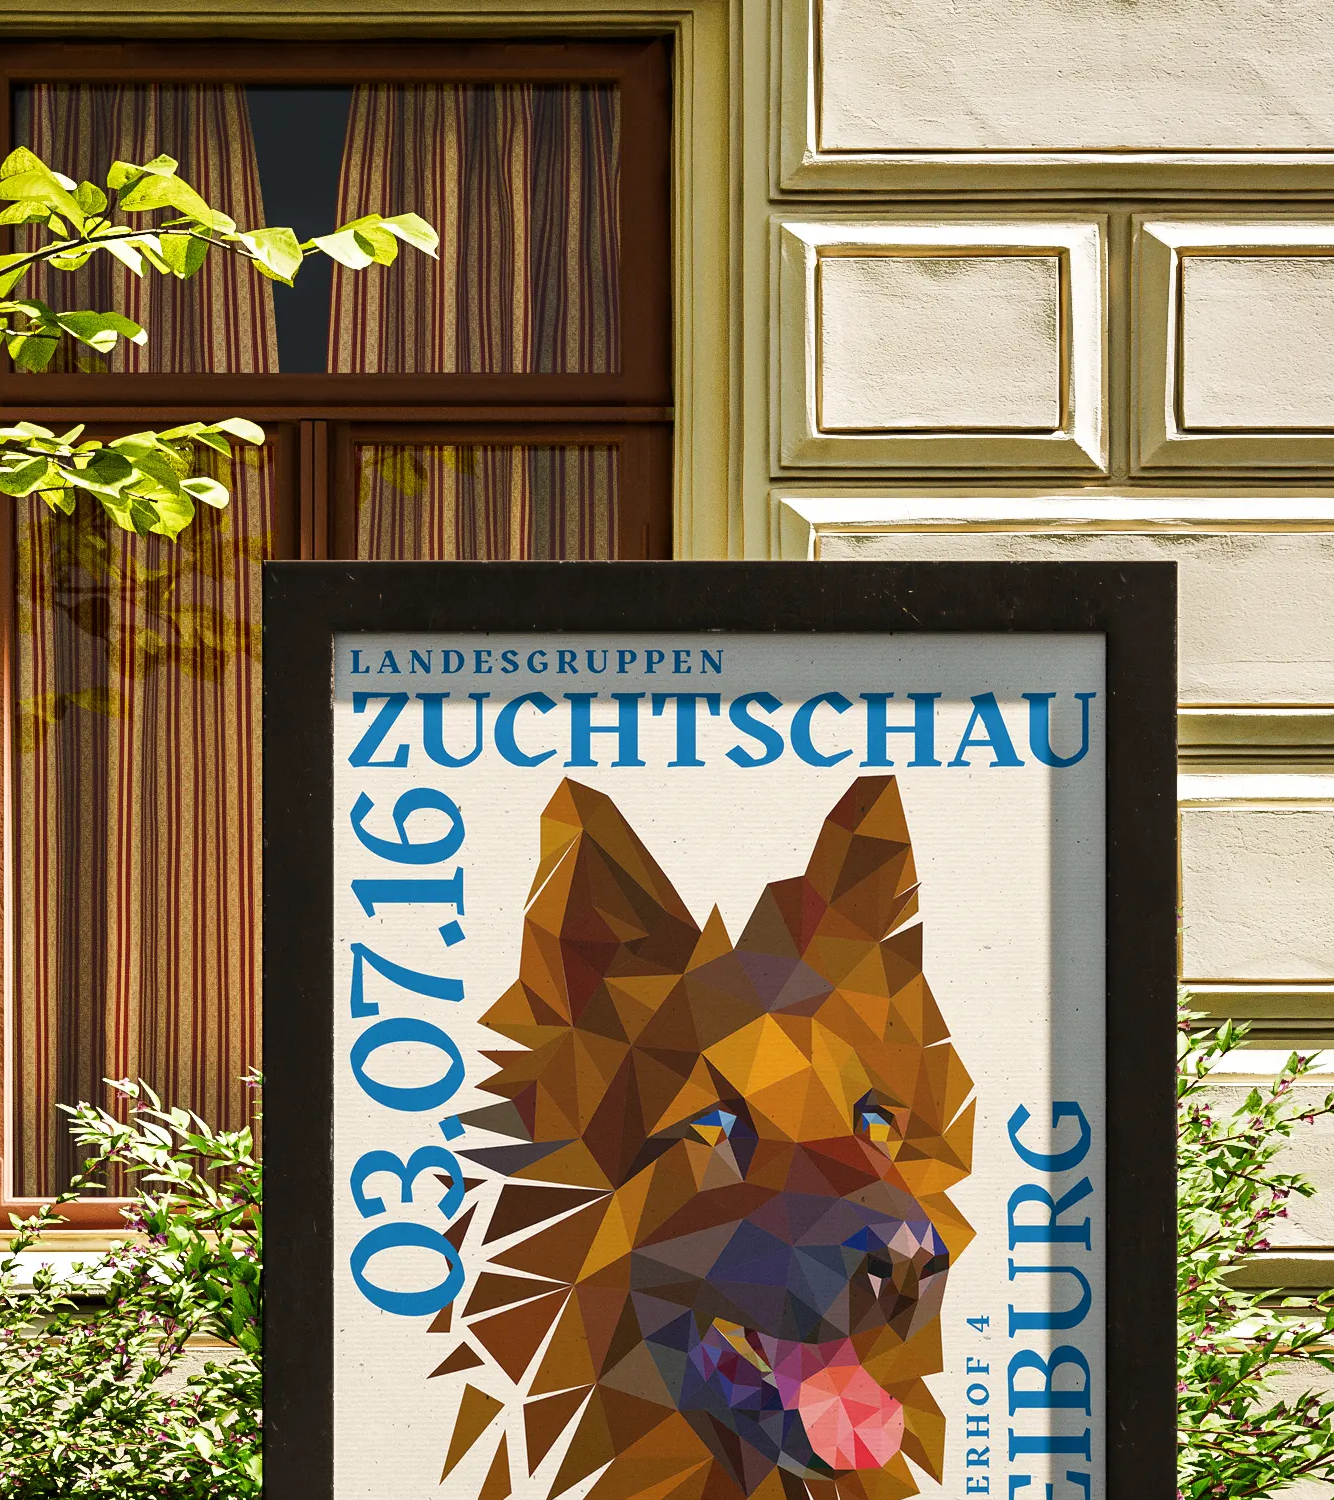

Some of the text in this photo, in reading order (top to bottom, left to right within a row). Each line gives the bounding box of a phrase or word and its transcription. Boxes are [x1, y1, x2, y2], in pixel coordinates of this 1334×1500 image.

[350, 649, 724, 675] LANDESGRUPPEN
[348, 691, 1098, 768] ZUCHTSCHAU
[349, 787, 466, 1317] 03.07.16
[966, 1315, 990, 1333] 4
